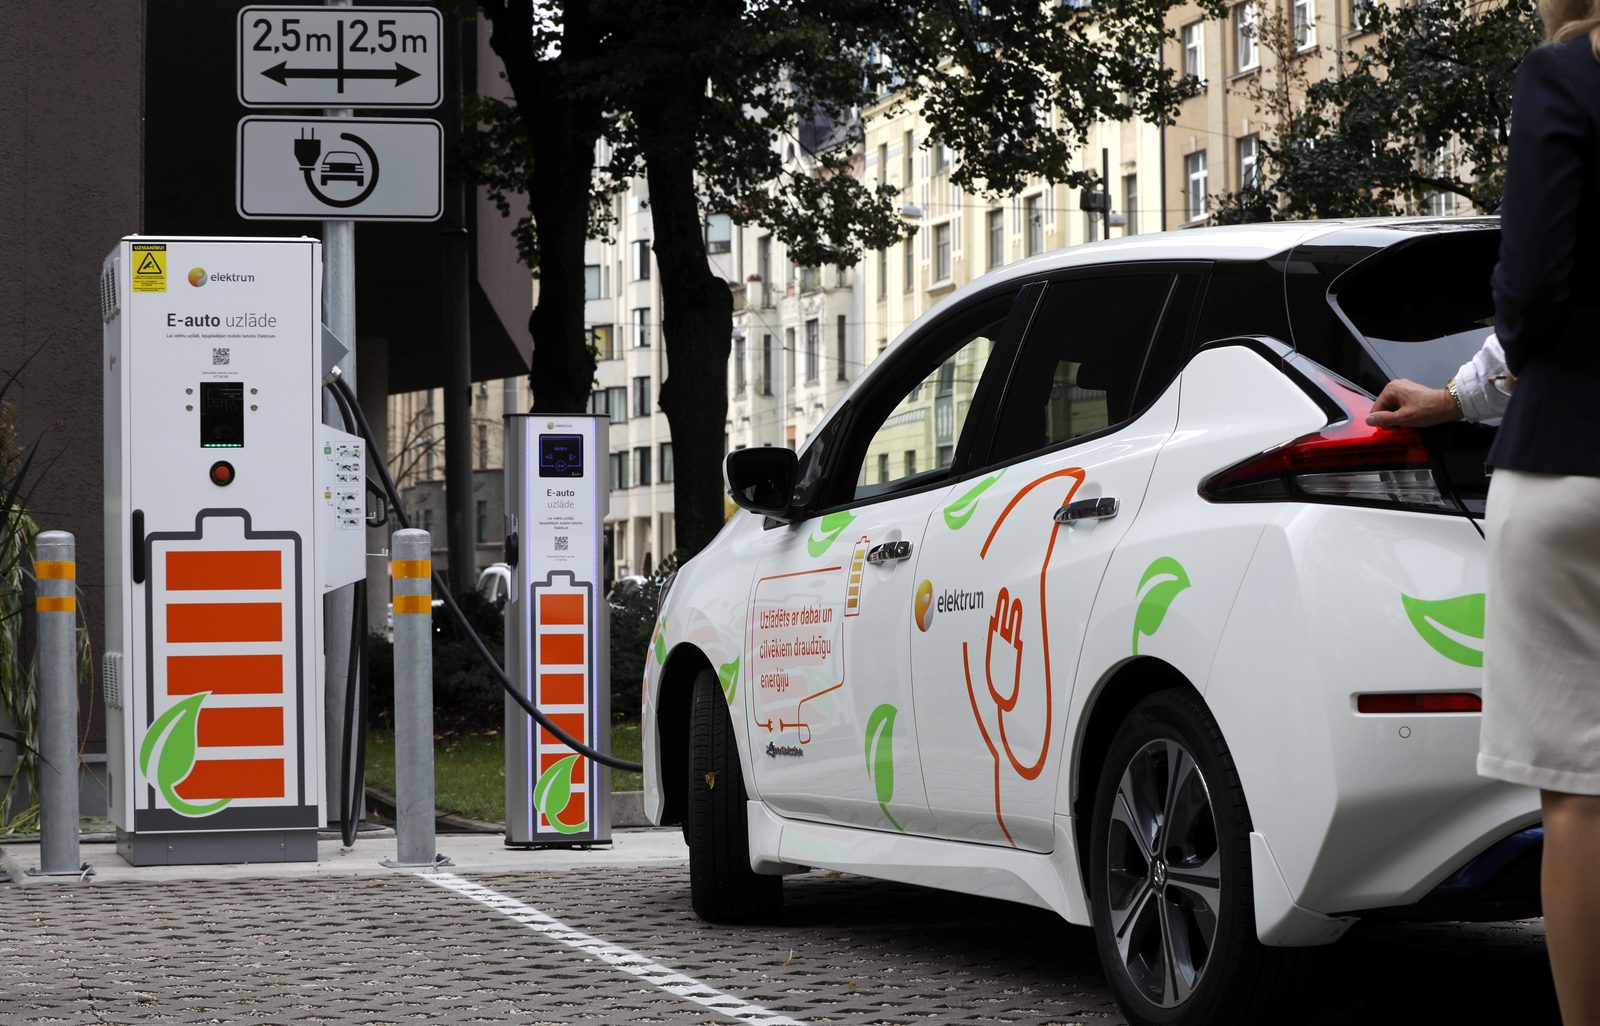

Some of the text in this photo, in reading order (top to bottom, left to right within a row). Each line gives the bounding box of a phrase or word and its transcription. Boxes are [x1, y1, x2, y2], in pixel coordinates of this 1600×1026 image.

[252, 18, 331, 54] 2,5 m
[349, 19, 427, 55] 2,5 m
[210, 272, 255, 283] elektrum
[167, 313, 277, 328] E-auto uzlāde
[546, 489, 575, 497] E-auto
[547, 500, 575, 509] uzlāde
[937, 589, 984, 613] elektrum
[760, 603, 833, 630] Uzlādēts ar dabai un
[759, 635, 831, 660] cilvēkiem draudzīgu
[760, 667, 789, 692] enerģiju
